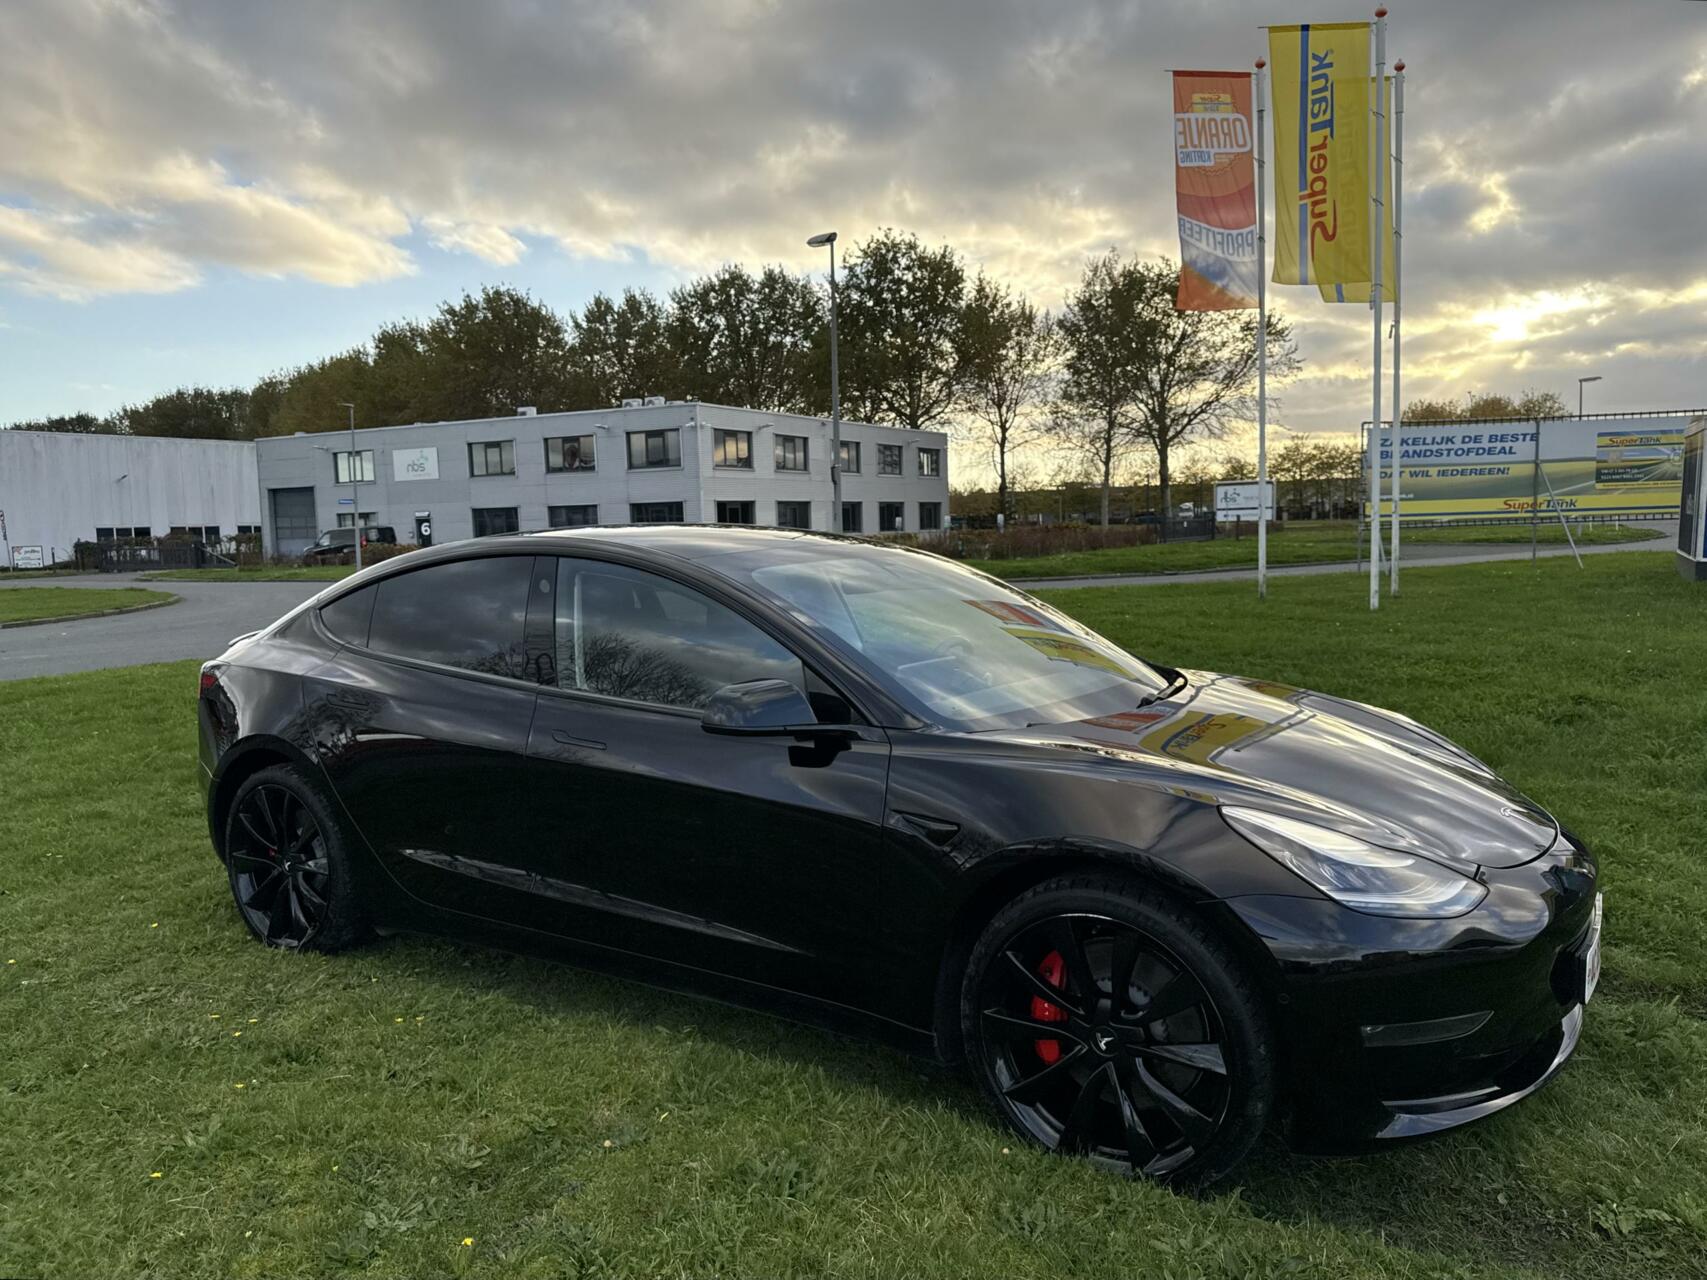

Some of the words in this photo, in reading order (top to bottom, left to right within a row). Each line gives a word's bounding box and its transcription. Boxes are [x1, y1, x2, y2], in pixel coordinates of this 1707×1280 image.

[1380, 435, 1456, 447] ZKELIJK
[1461, 434, 1484, 445] DE
[1488, 432, 1538, 444] BESTE
[1380, 445, 1517, 459] BANDSTOFDEAL
[1409, 468, 1432, 478] WIL
[1436, 466, 1511, 477] IEDEREEN!
[421, 522, 430, 535] 6
